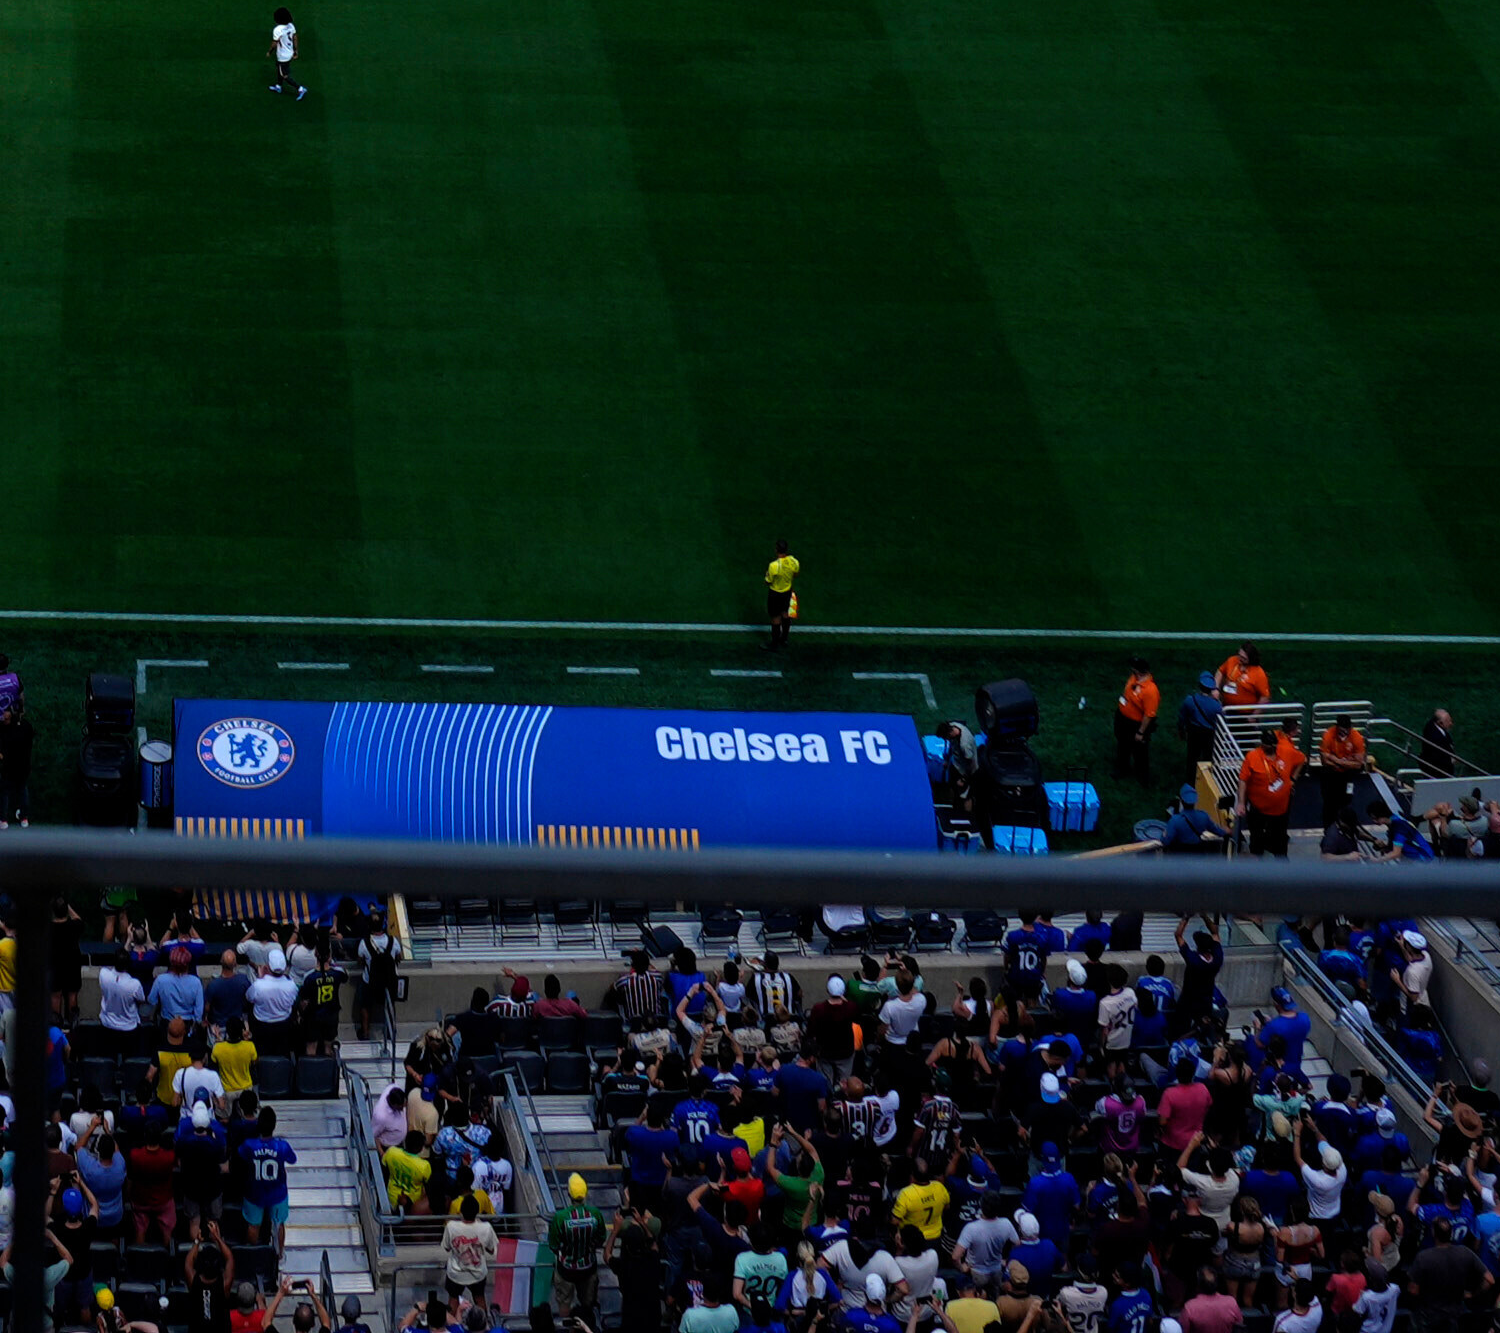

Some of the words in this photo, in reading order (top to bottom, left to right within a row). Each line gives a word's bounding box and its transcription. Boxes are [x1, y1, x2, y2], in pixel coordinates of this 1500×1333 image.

[213, 719, 276, 736] CHELSEA
[656, 726, 828, 763] Chelsea
[840, 730, 892, 766] FC
[252, 1158, 279, 1182] 10
